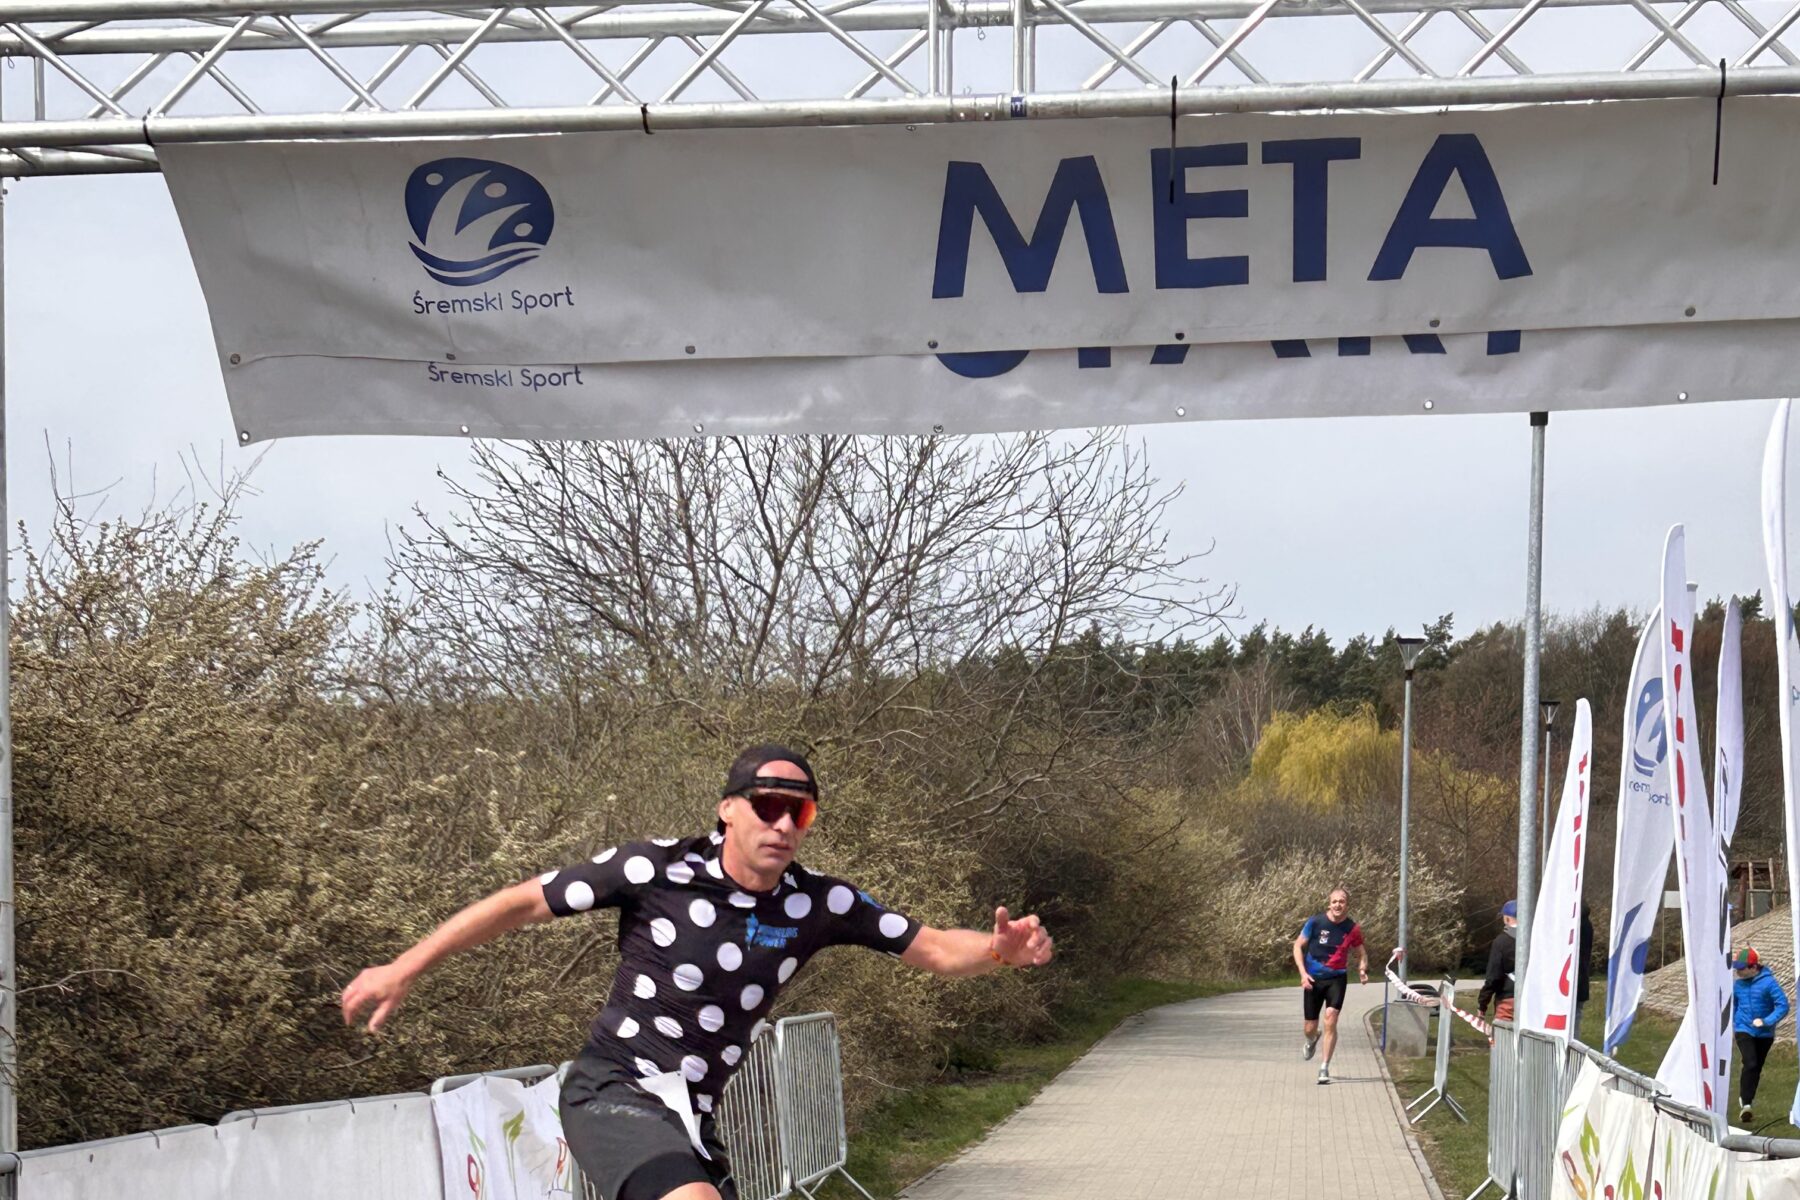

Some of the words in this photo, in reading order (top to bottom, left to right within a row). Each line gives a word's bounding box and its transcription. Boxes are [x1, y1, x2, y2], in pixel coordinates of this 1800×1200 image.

[932, 133, 1534, 300] META
[413, 289, 504, 315] Śremski
[511, 286, 575, 315] Sport
[521, 365, 583, 392] Sport
